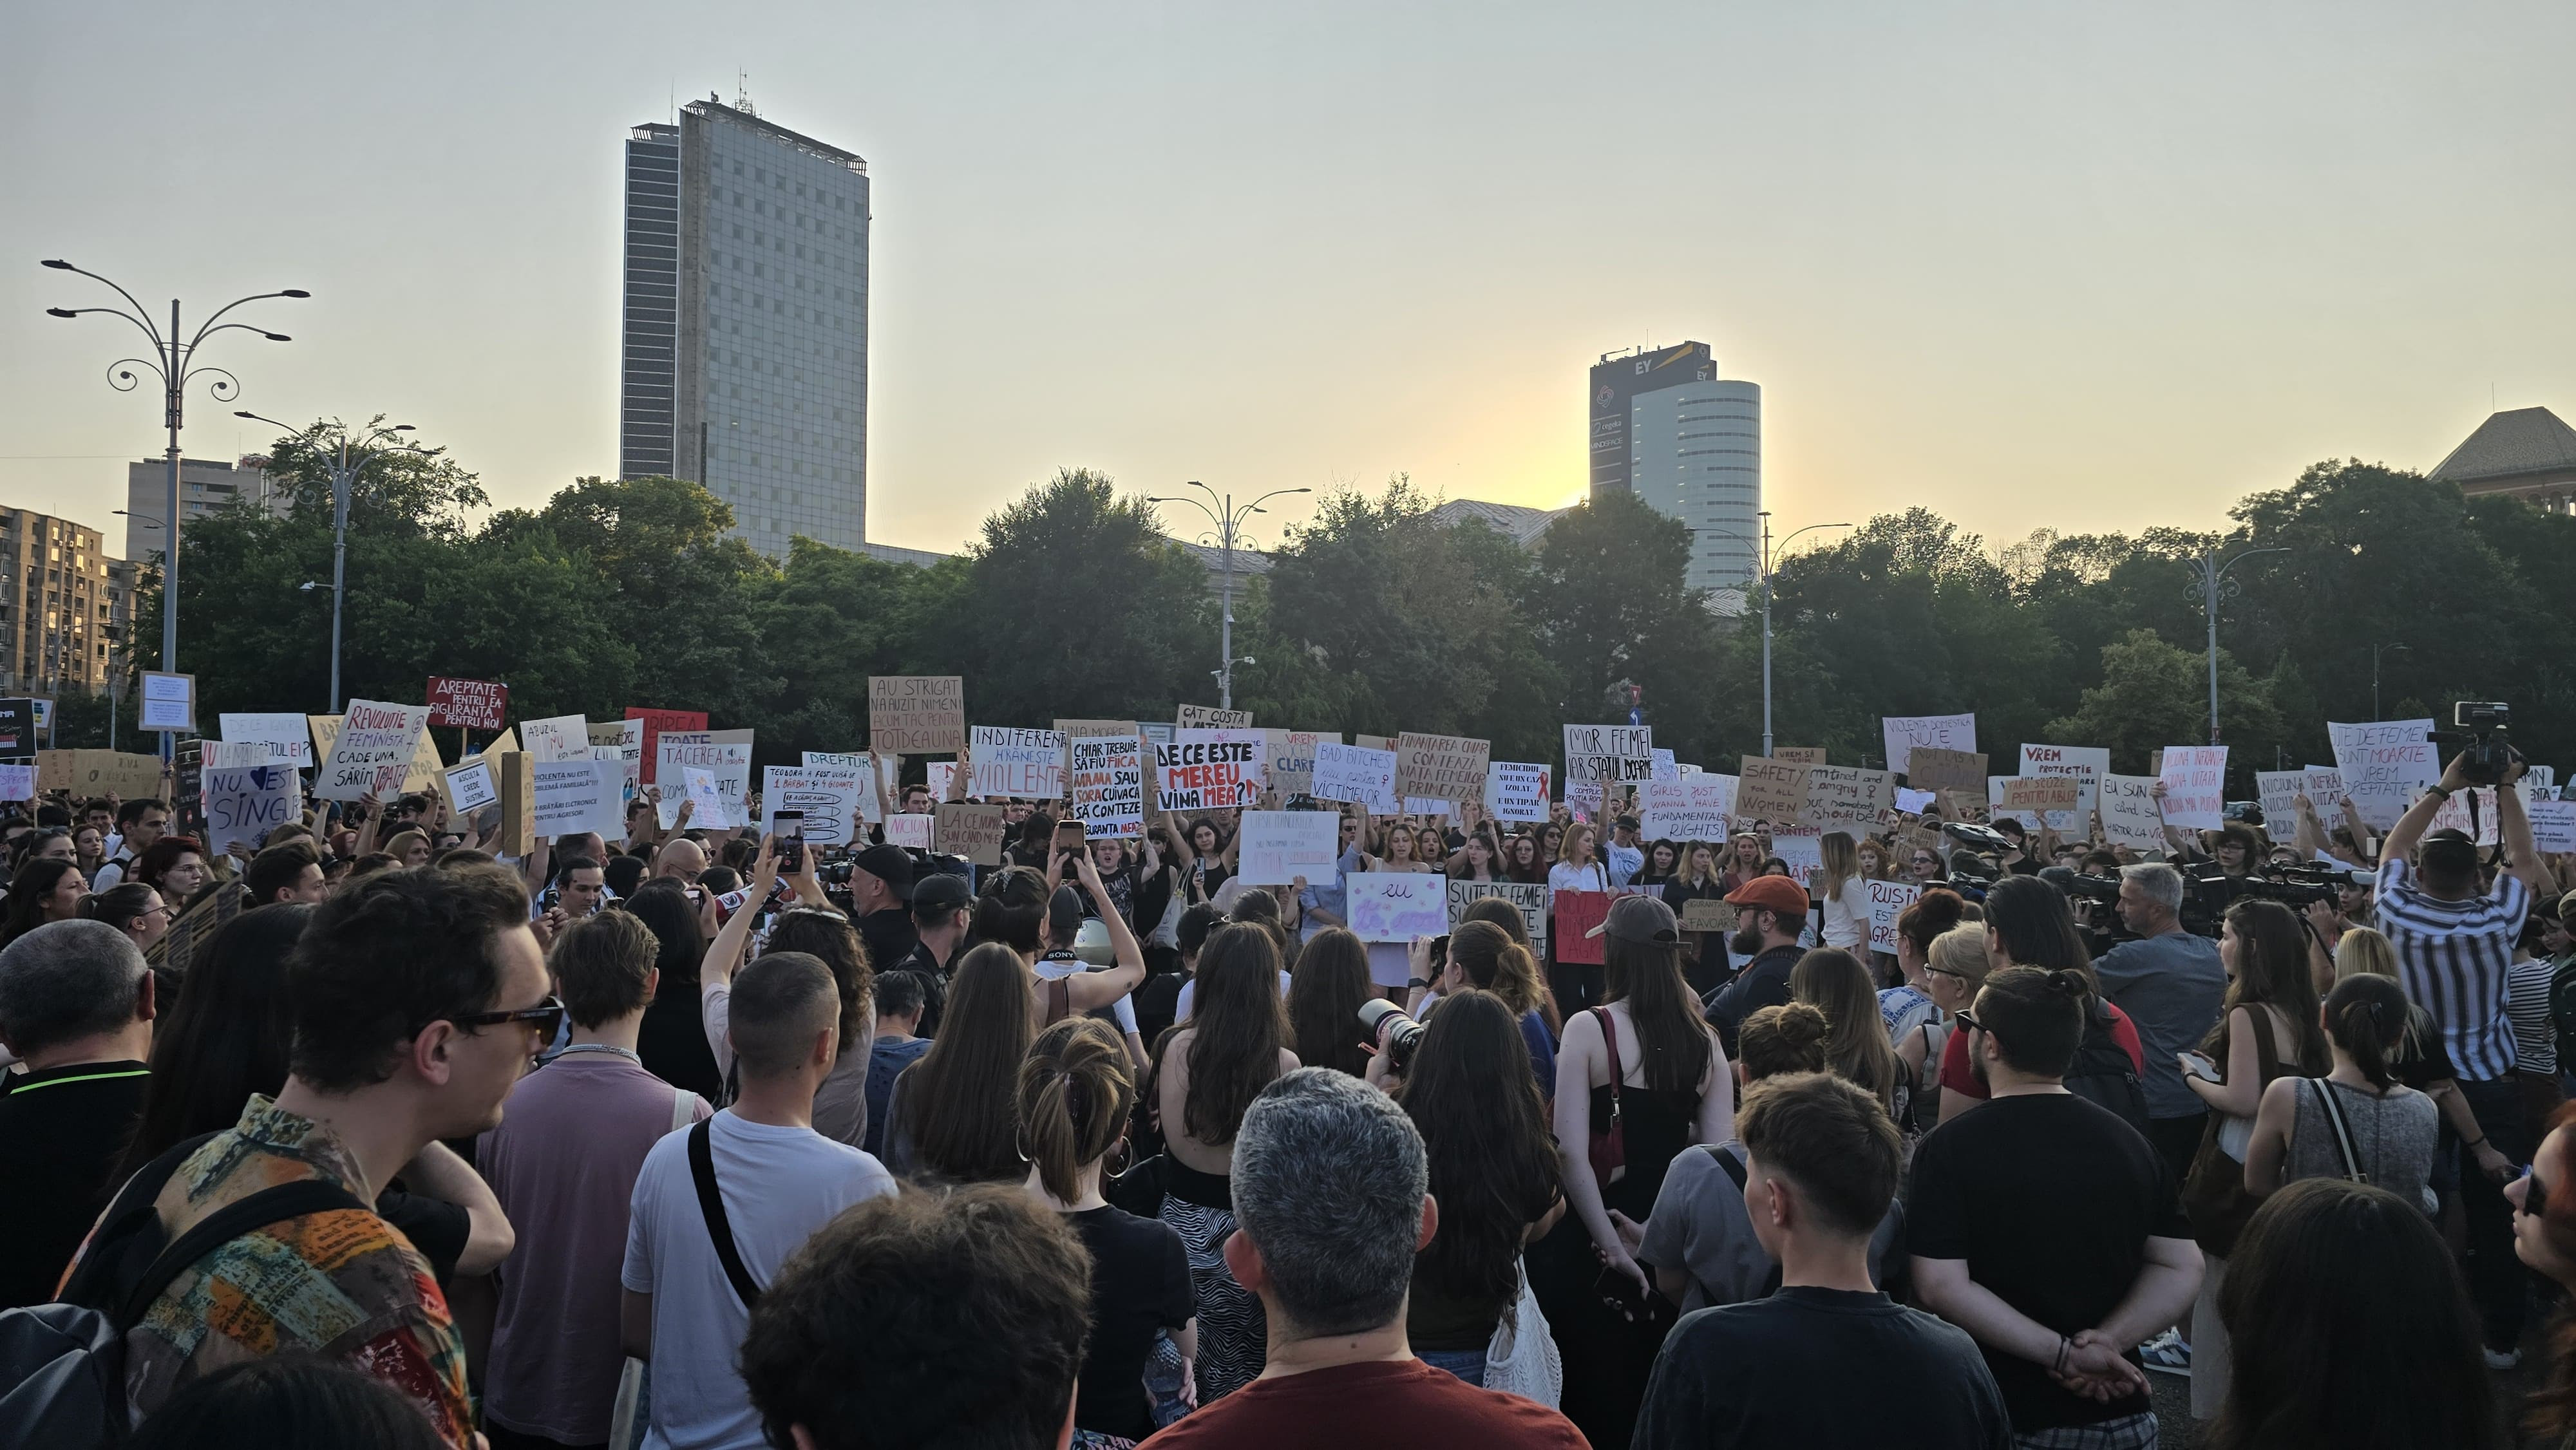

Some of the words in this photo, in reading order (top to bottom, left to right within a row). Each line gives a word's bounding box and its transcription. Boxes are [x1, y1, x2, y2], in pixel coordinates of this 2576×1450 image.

[1635, 359, 1653, 375] EY
[1697, 370, 1707, 381] EY
[1590, 437, 1624, 450] MINDSPACE
[876, 679, 898, 696] AU
[904, 679, 959, 696] STRIGAT
[453, 695, 486, 707] PENTRU
[489, 697, 502, 708] EA
[922, 697, 962, 710] NIMENI
[446, 715, 480, 727] PENTRU
[484, 717, 500, 729] NOI
[873, 713, 901, 728] ACUM
[902, 713, 926, 727] TAC
[927, 712, 961, 727] PENTRU
[527, 724, 558, 738] ABUZUL
[871, 728, 961, 750] TOTDEAUNA
[1284, 733, 1318, 745] VREM
[1909, 730, 1932, 746] NU
[1939, 730, 1951, 744] E
[2356, 727, 2374, 746] DE
[2377, 725, 2430, 744] FEMEI
[551, 736, 564, 750] NU
[1074, 741, 1103, 758] CHIAR
[1104, 740, 1138, 756] TREBUIE
[1399, 734, 1458, 753] FINANȚAREA
[1569, 728, 1604, 754] MOR
[337, 751, 372, 764] CADE
[664, 744, 723, 766] TĂCEREA
[1156, 744, 1180, 767] DE
[1182, 743, 1205, 766] CE
[1208, 742, 1253, 764] ESTE
[1320, 744, 1341, 762] BAD
[1345, 746, 1392, 769] BITCHES
[1412, 751, 1479, 770] CONTEAZĂ
[2025, 746, 2061, 762] VREM
[2338, 748, 2369, 765] SUNT
[2369, 746, 2429, 764] MOARTE
[1074, 757, 1088, 771] SĂ
[1090, 757, 1106, 769] FIU
[1499, 764, 1541, 773] FEMICIDUL
[1567, 756, 1588, 780] IAR
[1588, 756, 1625, 782] STATUL
[334, 766, 374, 787] SĂRIM
[769, 767, 803, 777] TEODORA
[815, 770, 831, 778] FOST
[1074, 771, 1112, 787] MAMA
[1114, 770, 1139, 786] SAU
[1168, 763, 1240, 790] MEREU
[1435, 769, 1487, 786] FEMEILOR
[1745, 764, 1806, 787] SAFETY
[1830, 768, 1857, 782] tired
[1862, 775, 1883, 784] and
[2358, 766, 2400, 782] VREM
[211, 774, 243, 795] NU
[462, 780, 481, 792] CREDE
[1505, 784, 1533, 793] IZOLAT.
[1649, 784, 1683, 798] GIRLS
[1690, 786, 1718, 799] JUST
[1817, 782, 1859, 798] angry
[2034, 778, 2066, 789] SCUZE
[2104, 778, 2118, 795] EU
[2262, 777, 2305, 794] NICIUNA
[1075, 788, 1102, 804] SORA
[1159, 787, 1200, 810] VINA
[1312, 780, 1381, 805] VICTIMELOR
[1776, 788, 1795, 796] ALL
[2011, 791, 2048, 805] PENTRU
[2050, 789, 2078, 804] ABUZ
[1516, 798, 1540, 807] TIPAR
[1650, 800, 1687, 809] WANNA
[1694, 798, 1719, 809] HAVE
[1741, 796, 1797, 813] WOMEN
[1830, 800, 1875, 814] somebody
[1075, 804, 1090, 820] SĂ
[1092, 802, 1141, 818] CONTEZE
[1502, 807, 1537, 816] IGNORAT.
[1651, 812, 1723, 824] FUNDAMENTAL
[1810, 808, 1854, 820] should
[942, 809, 962, 830] LA
[964, 813, 979, 829] CE
[1085, 823, 1119, 837] GURANȚA
[1669, 821, 1726, 838] RIGHTS!
[1772, 824, 1822, 837] SUNTEM
[2106, 824, 2134, 838] MARTOR
[2134, 826, 2147, 838] LA
[1381, 883, 1414, 899] eu
[1450, 881, 1488, 905] SUTE
[1510, 885, 1546, 910] FEMEI
[1720, 909, 1727, 917] O
